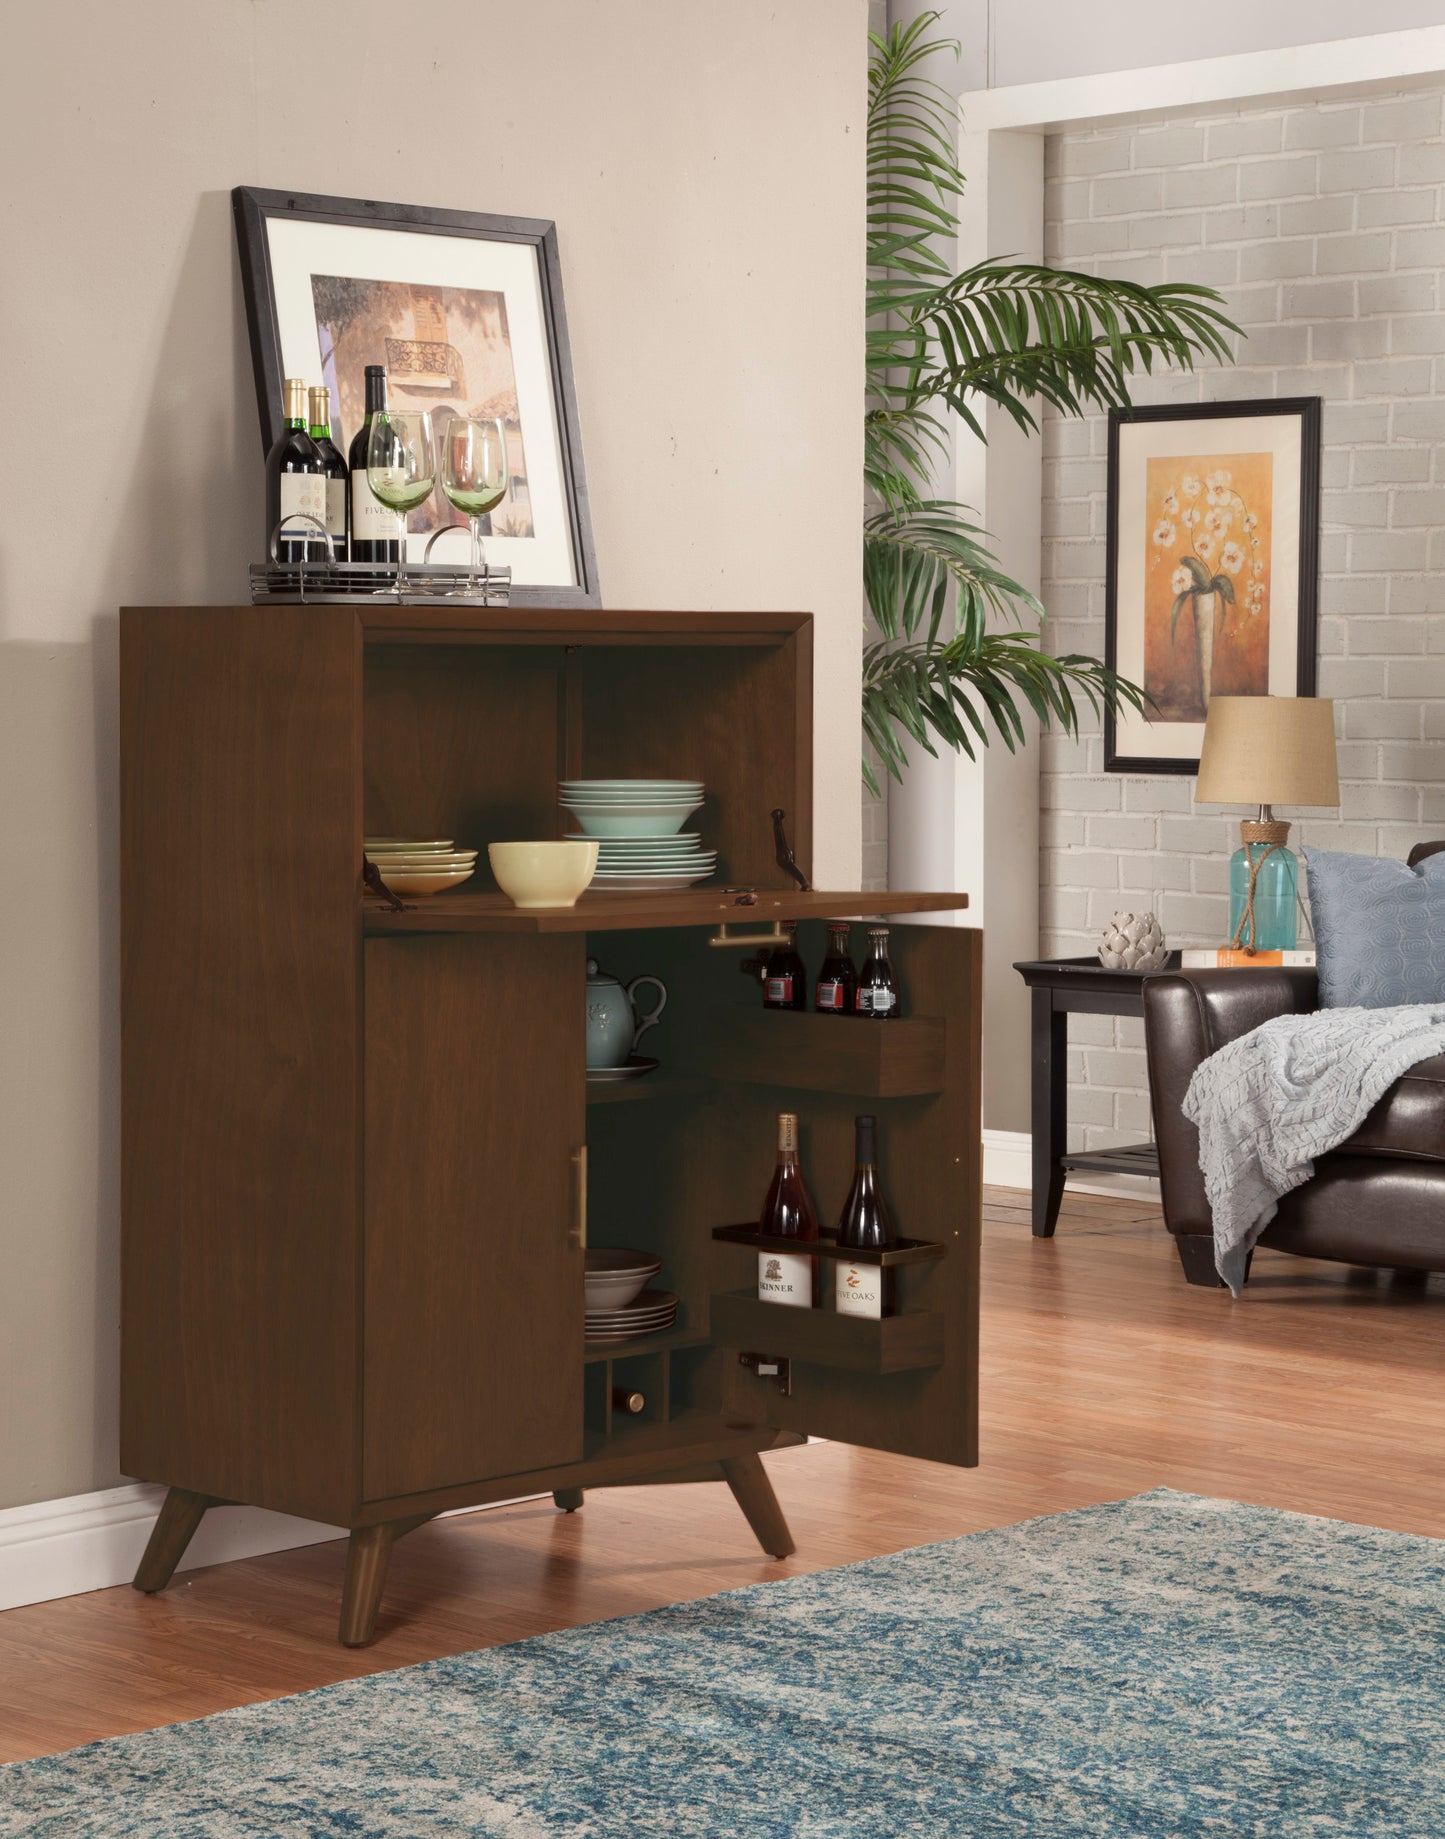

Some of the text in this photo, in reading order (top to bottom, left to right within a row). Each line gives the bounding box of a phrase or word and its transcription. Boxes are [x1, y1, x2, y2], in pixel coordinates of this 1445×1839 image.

[365, 506, 385, 515] FIVE
[836, 1289, 876, 1302] FIVE OAKS
